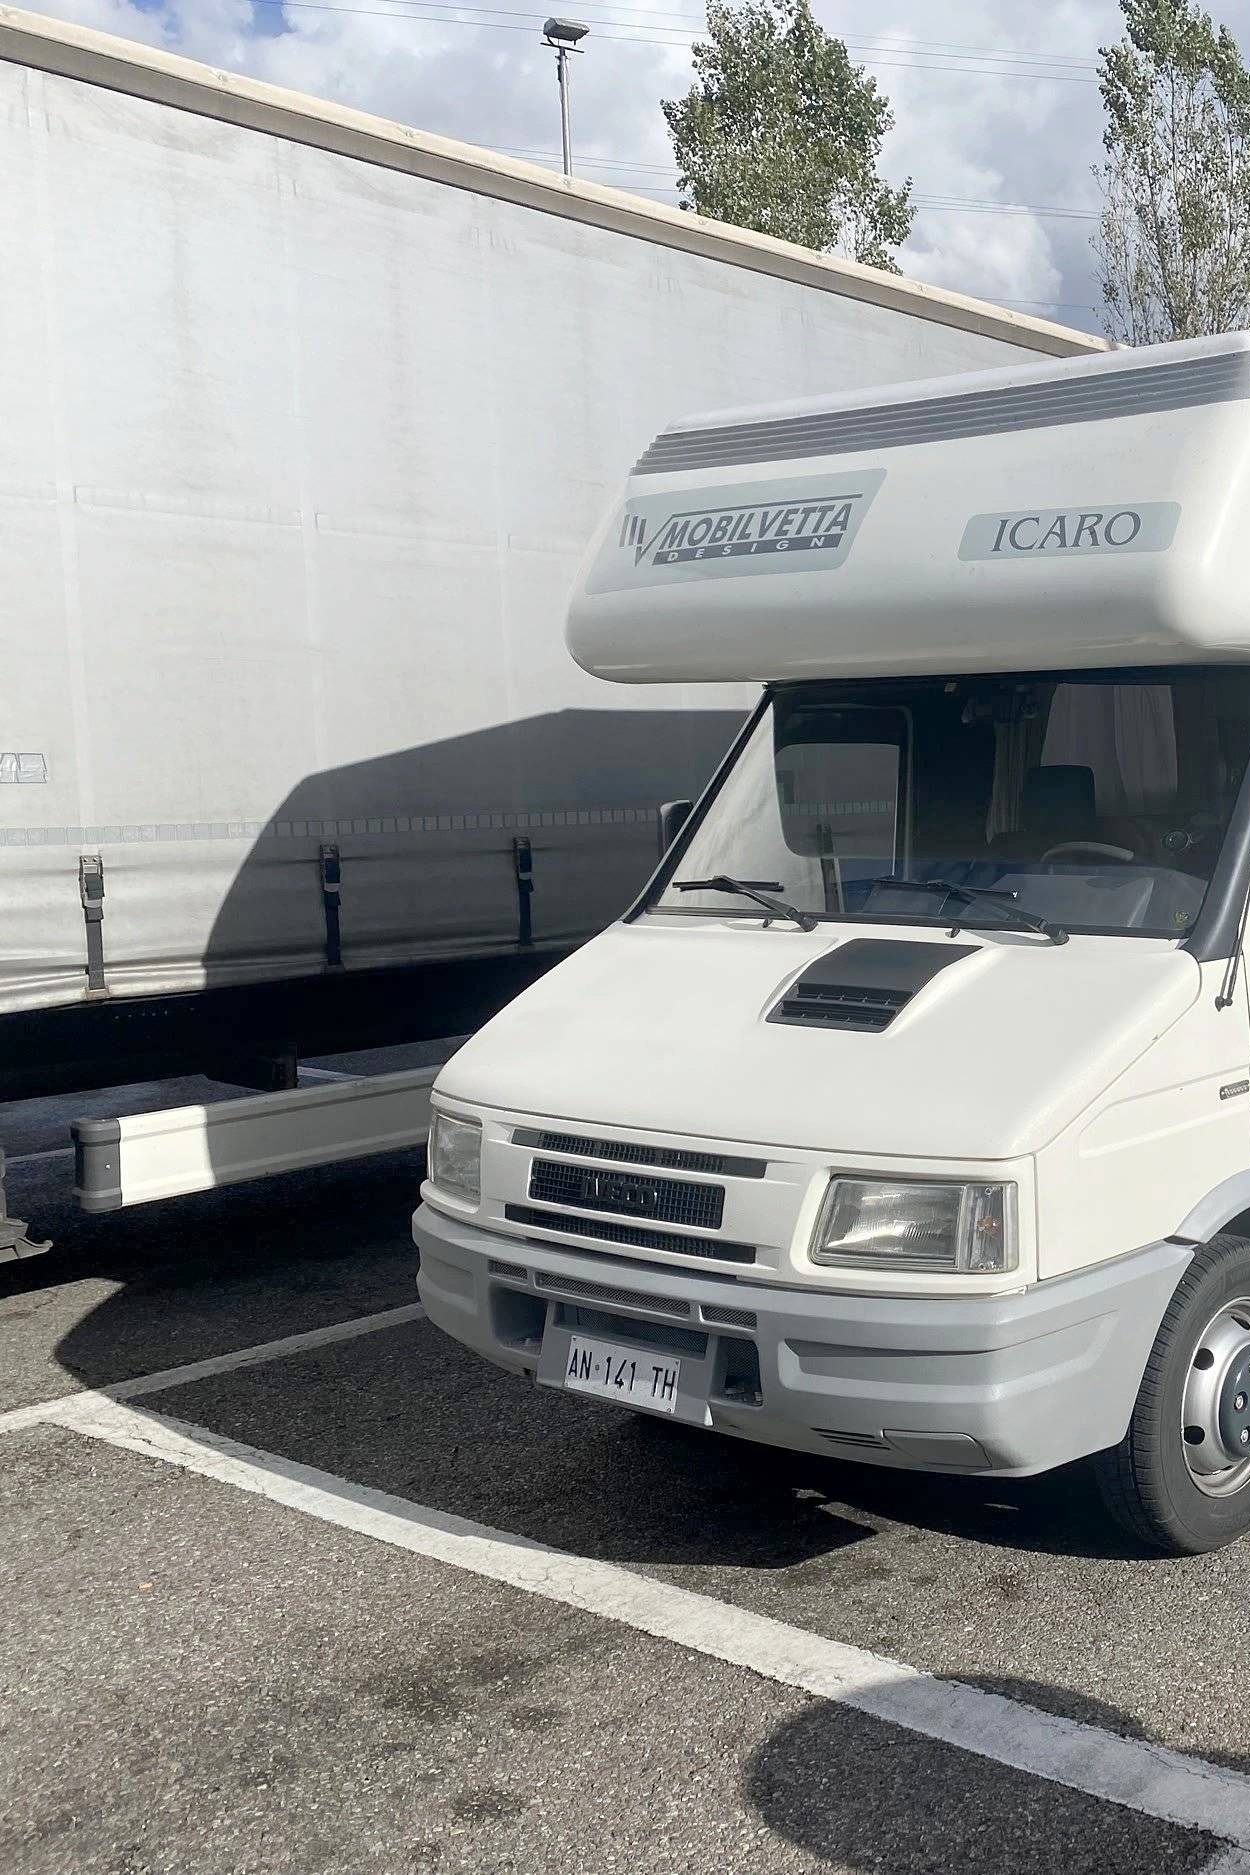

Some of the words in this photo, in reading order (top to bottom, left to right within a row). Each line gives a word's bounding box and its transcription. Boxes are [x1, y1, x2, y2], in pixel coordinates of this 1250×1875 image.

[658, 503, 853, 550] MOBILVETTA
[992, 511, 1141, 552] ICARO
[666, 537, 825, 562] DESIGN
[568, 1348, 592, 1380] AN
[605, 1356, 636, 1391] 141
[652, 1366, 676, 1401] TH
